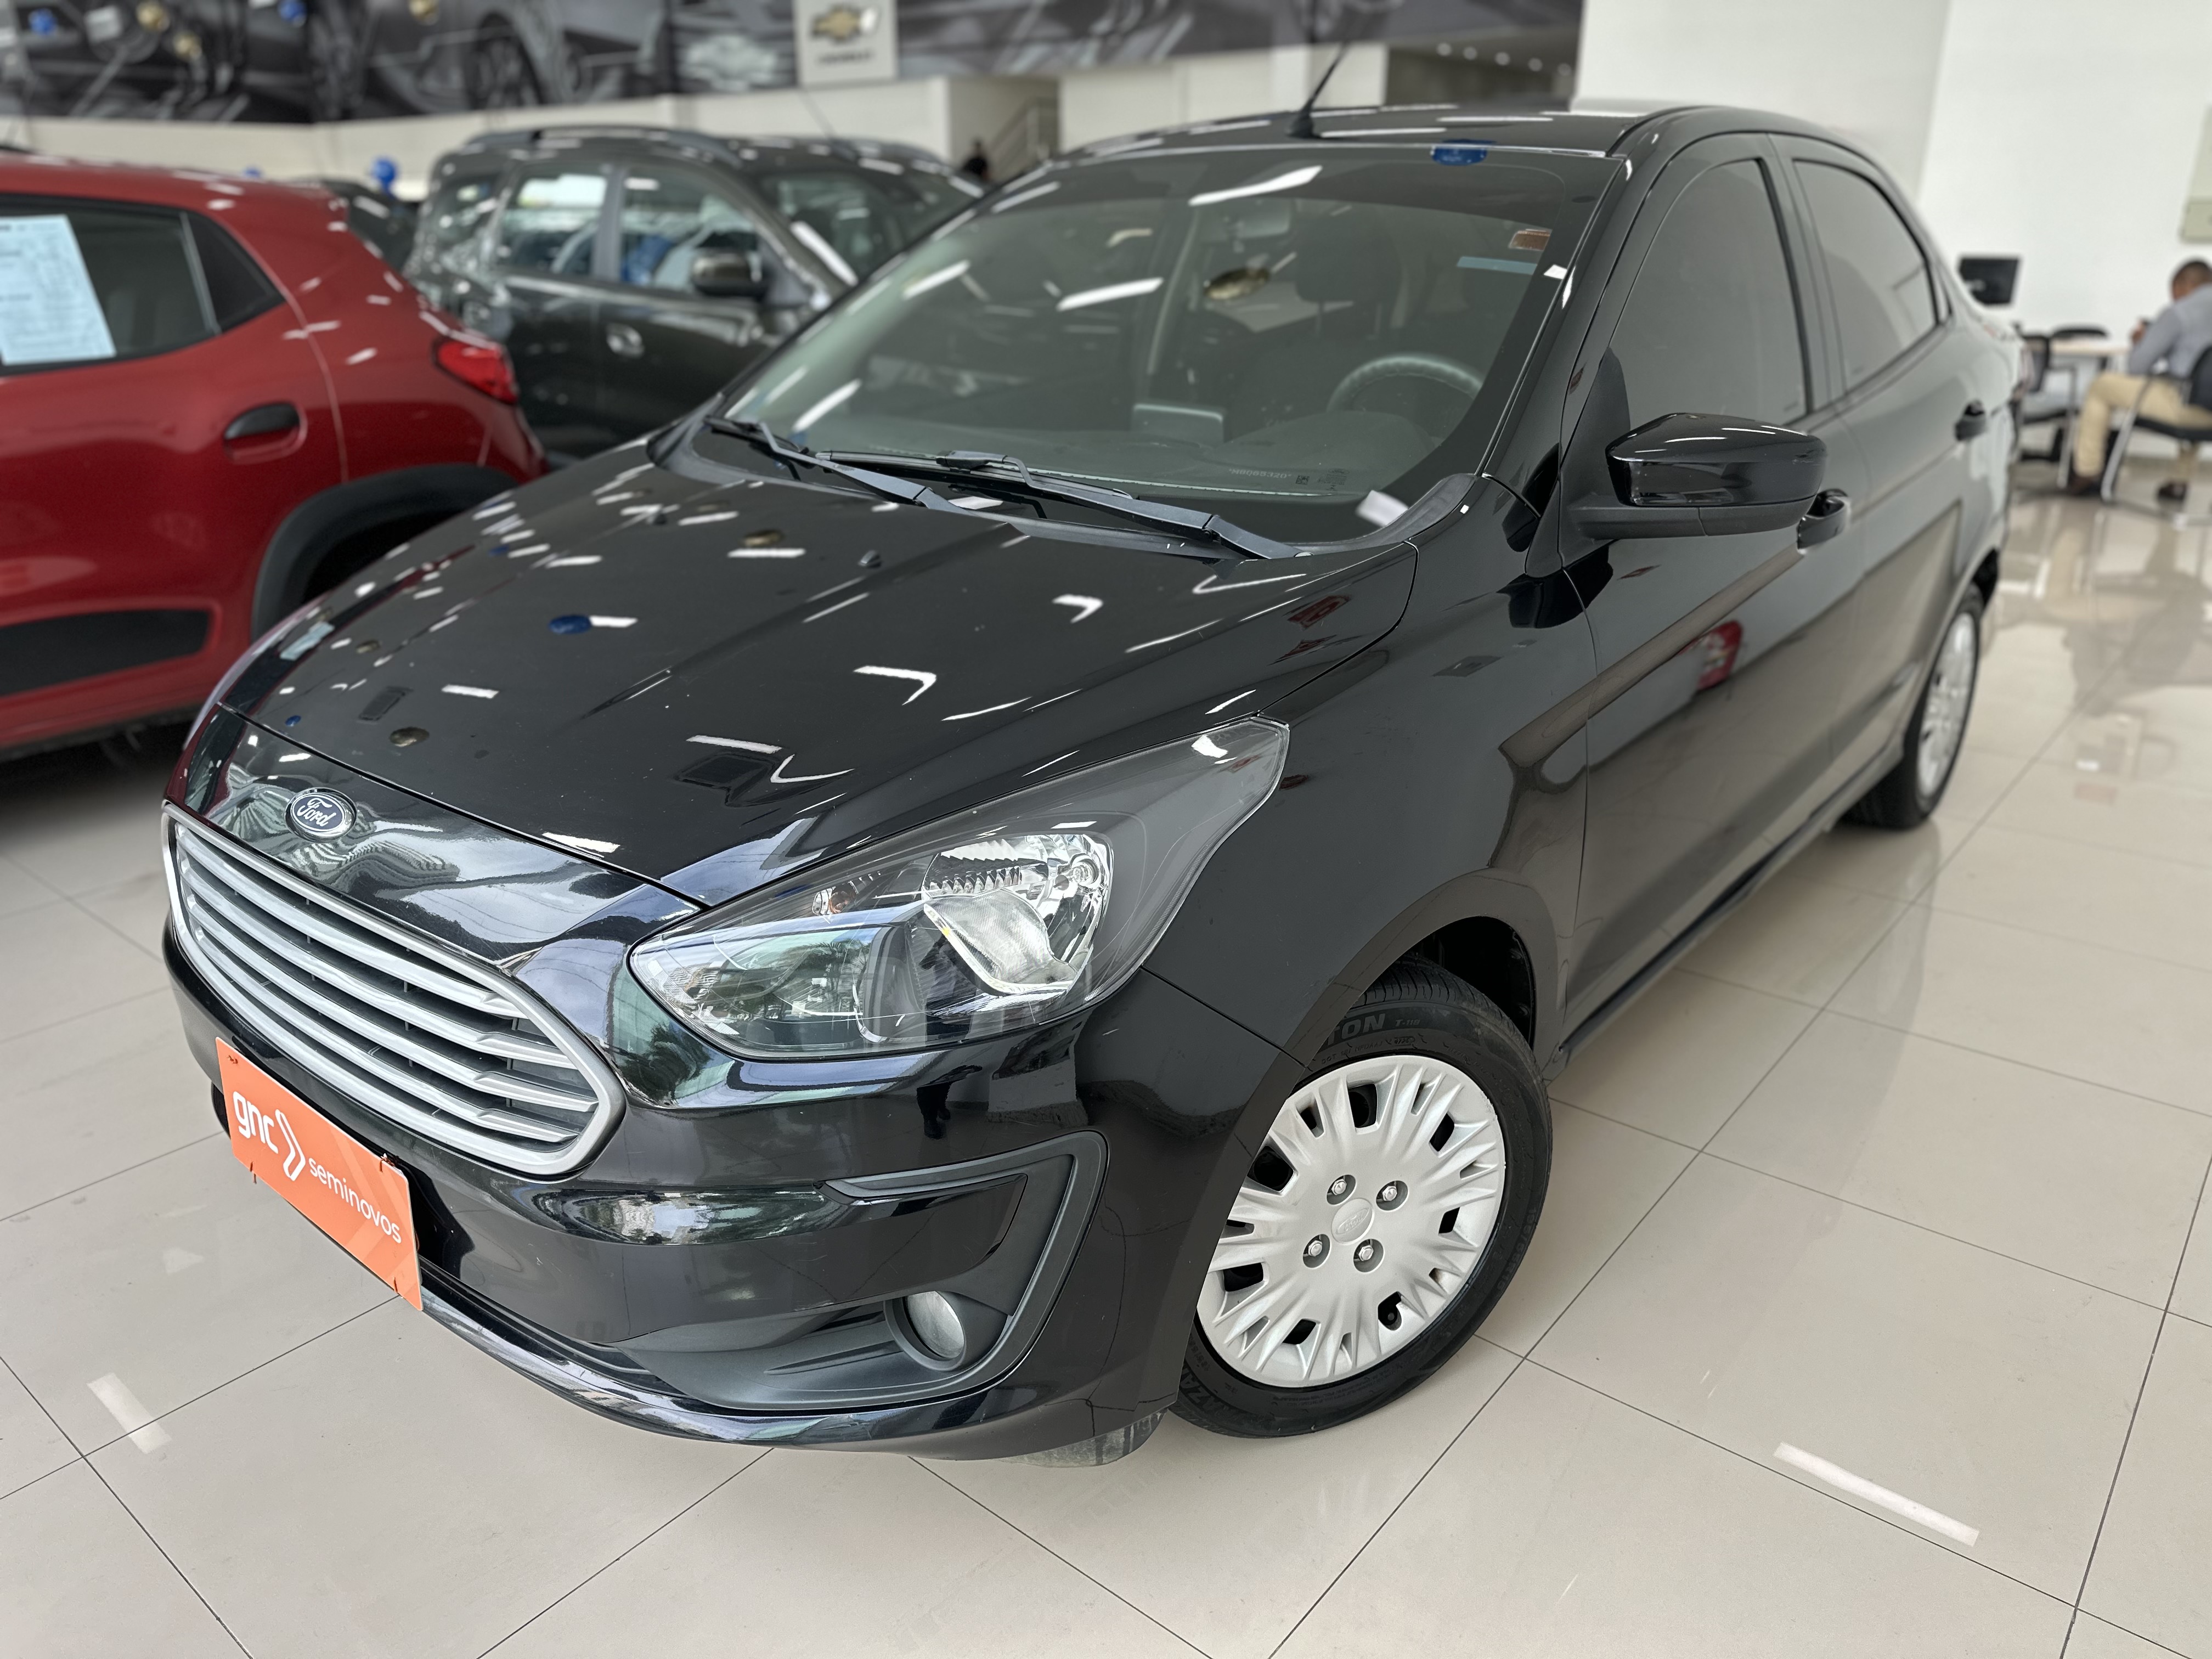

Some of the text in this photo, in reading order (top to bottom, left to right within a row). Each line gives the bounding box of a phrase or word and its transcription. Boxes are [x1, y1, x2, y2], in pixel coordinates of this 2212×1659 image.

[297, 797, 337, 827] Ford
[232, 1090, 402, 1244] gnc seminovos
